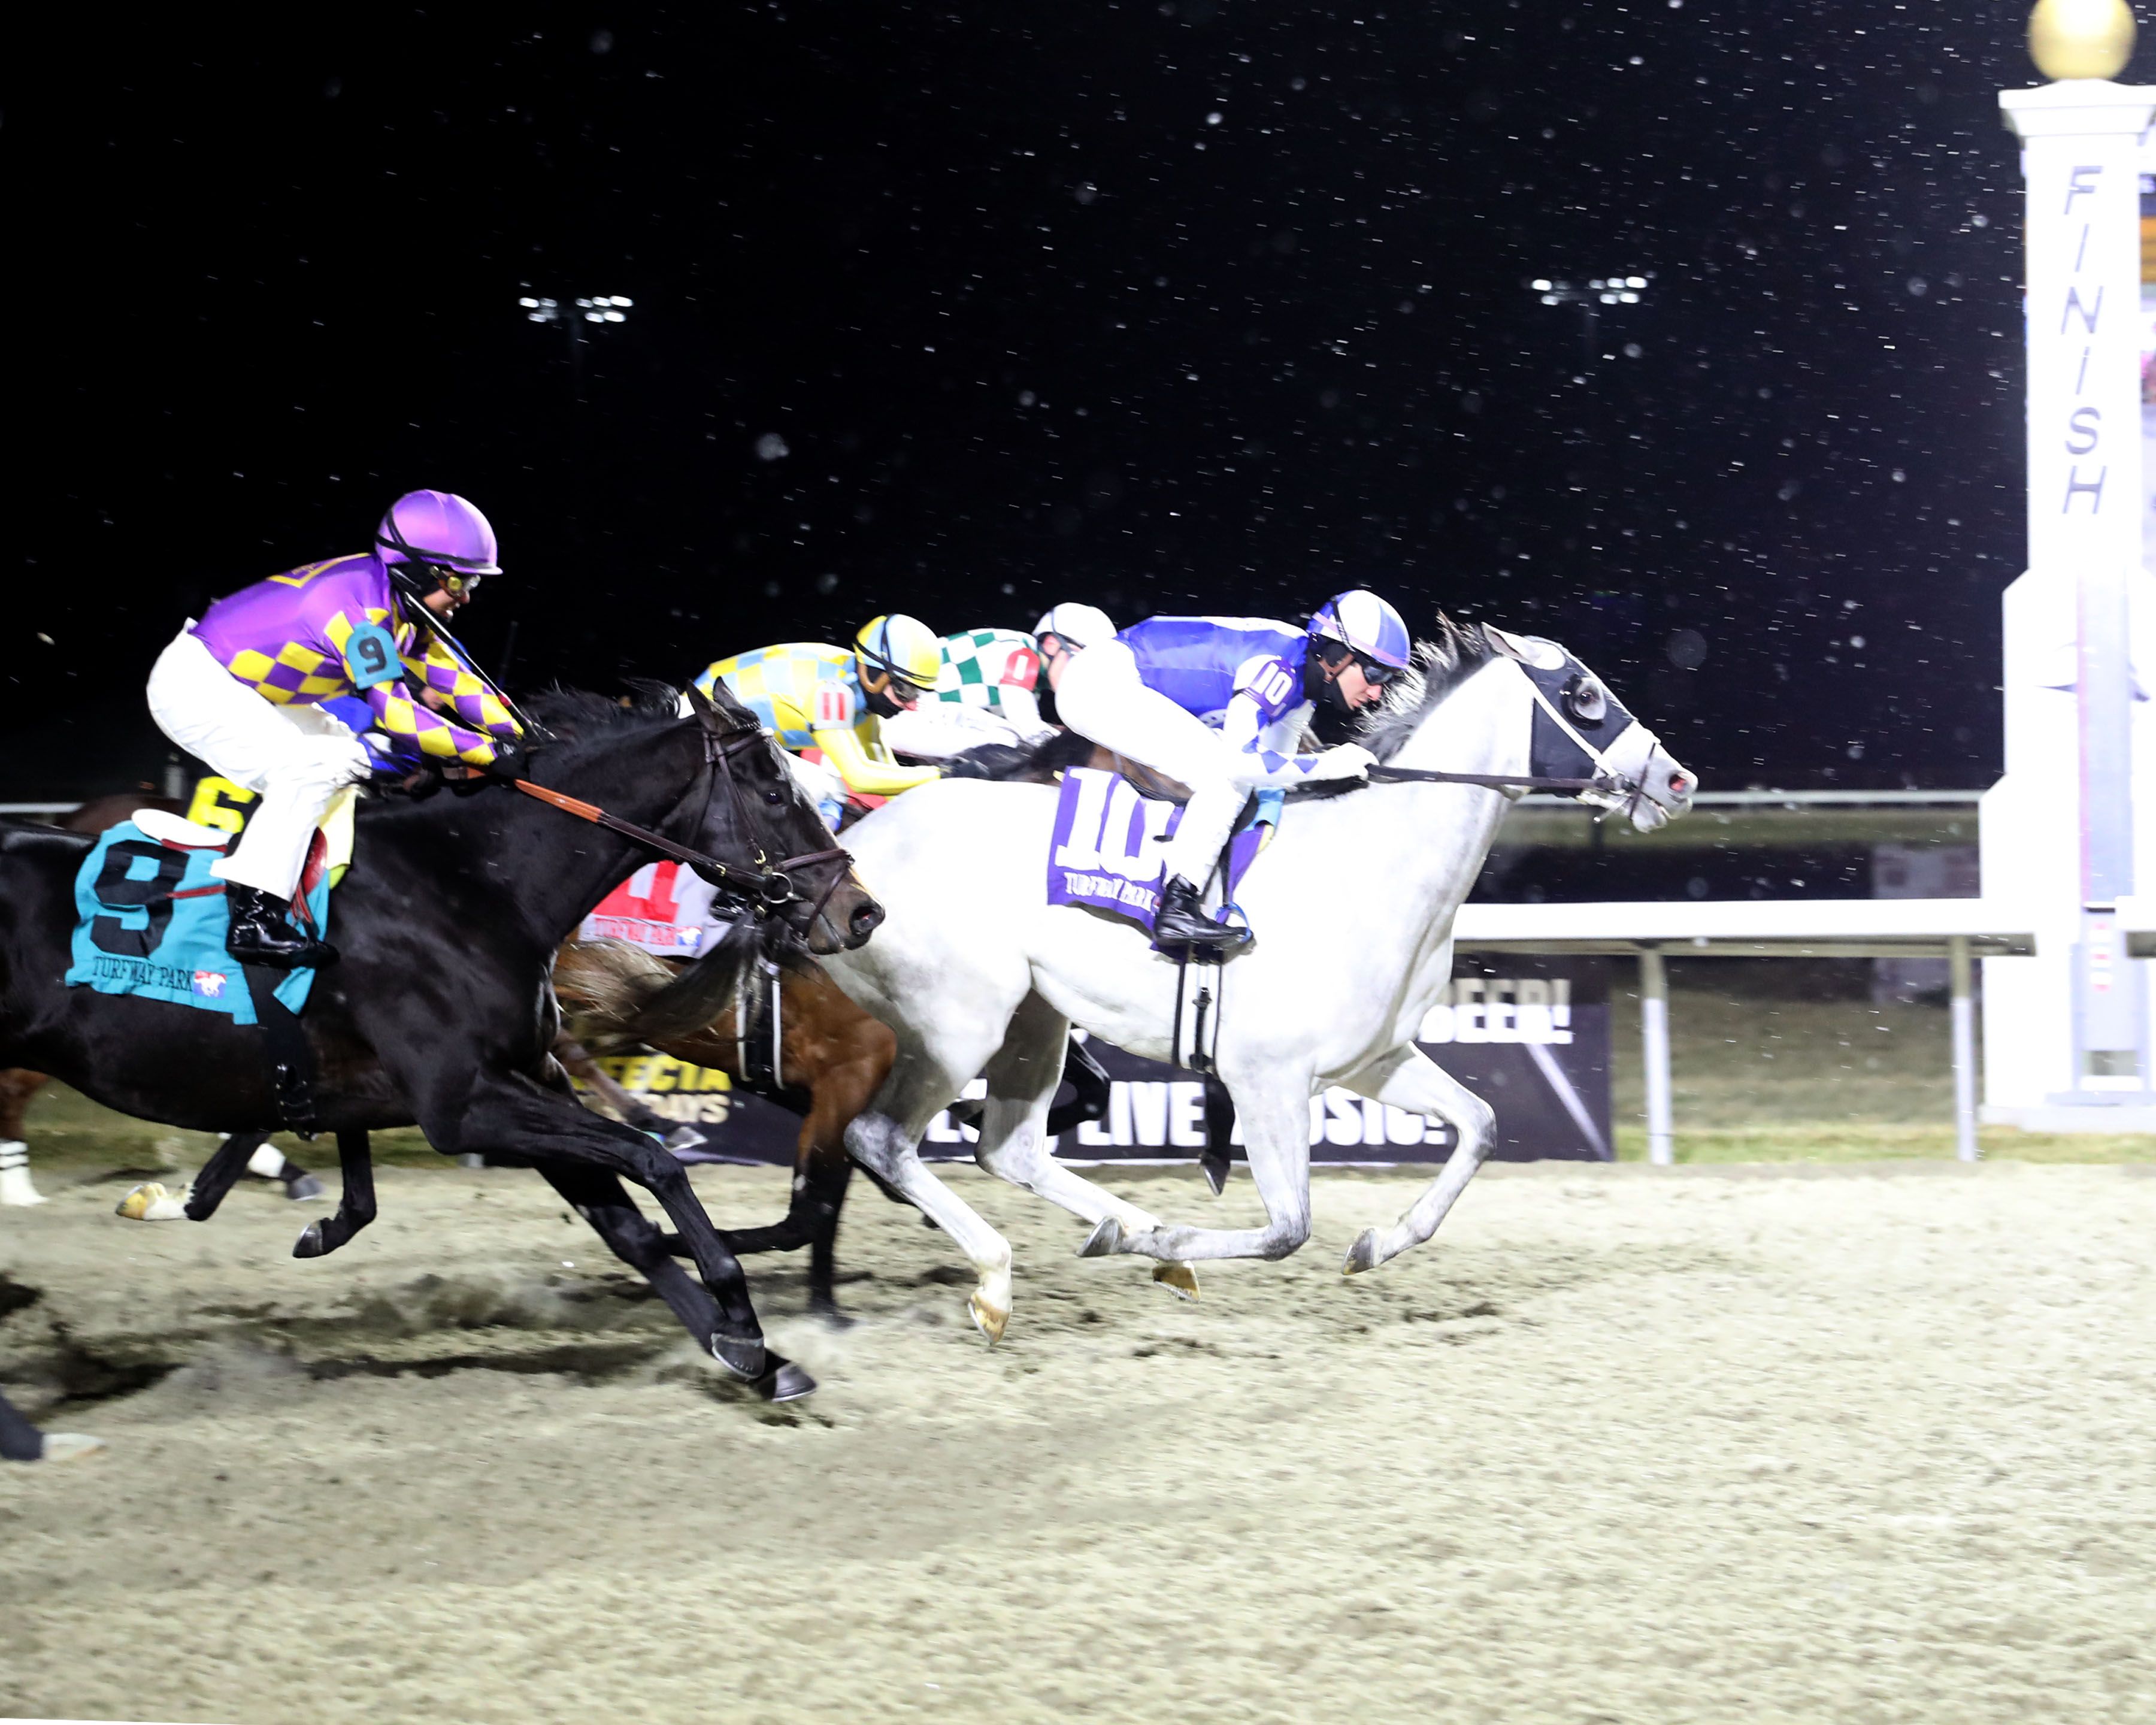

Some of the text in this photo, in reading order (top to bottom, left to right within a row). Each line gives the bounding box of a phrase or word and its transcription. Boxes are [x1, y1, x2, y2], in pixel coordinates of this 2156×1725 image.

[2061, 166, 2107, 515] FINISH
[358, 635, 387, 674] 9
[822, 691, 847, 721] 11
[1251, 661, 1294, 706] 10
[186, 776, 256, 834] 6
[90, 839, 190, 958] 9
[93, 956, 196, 992] TURFWAY PARK
